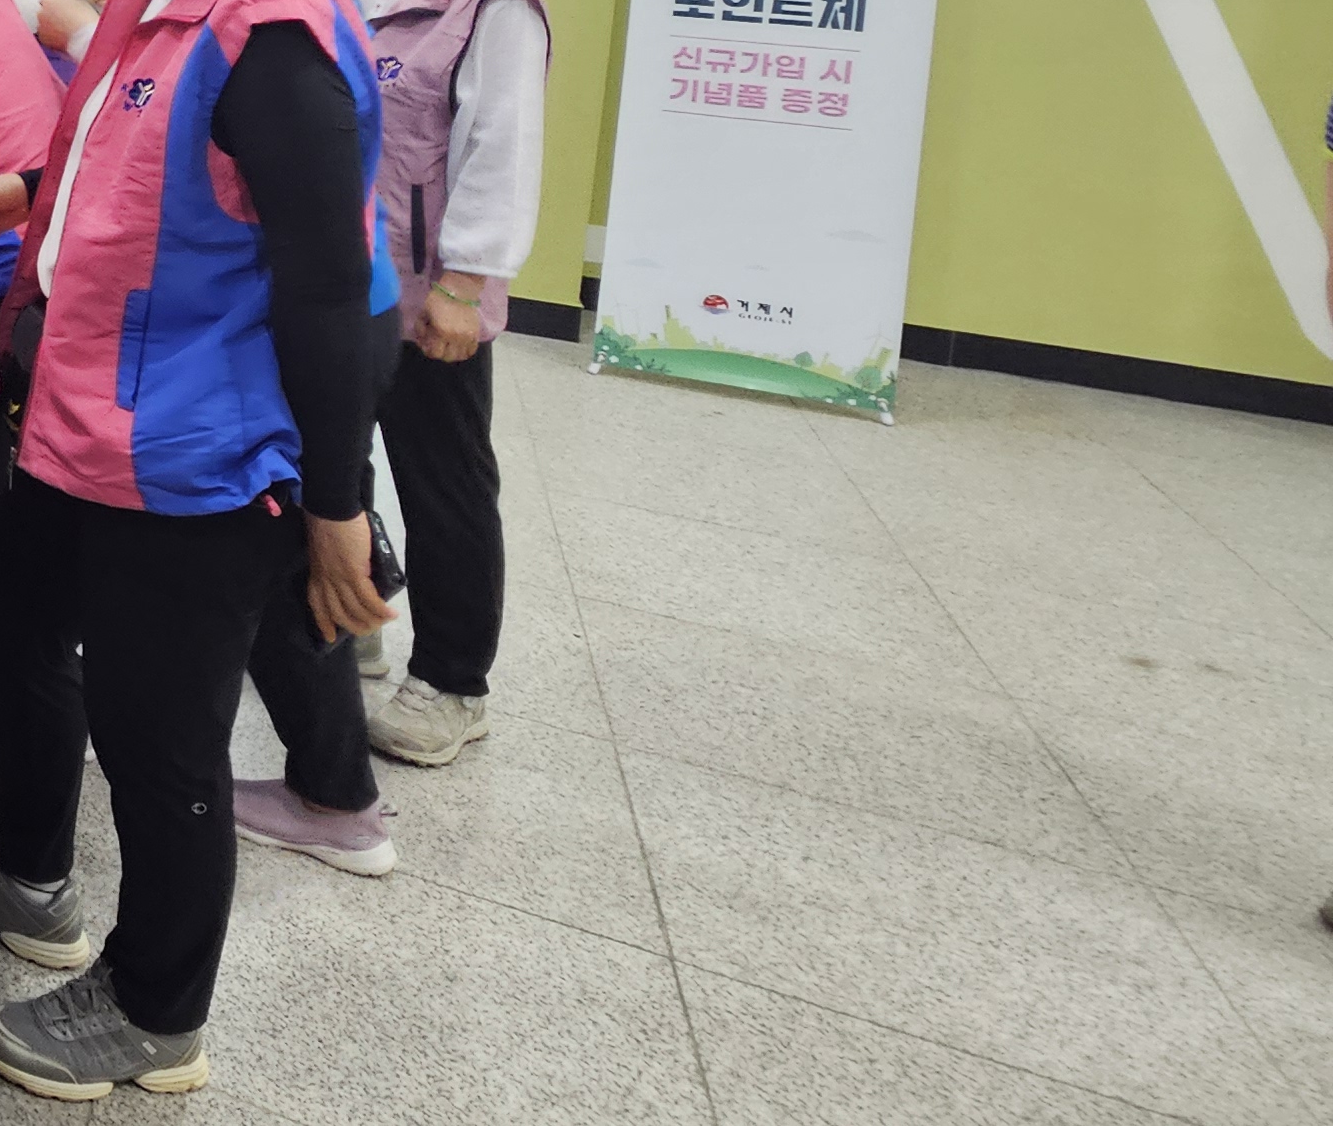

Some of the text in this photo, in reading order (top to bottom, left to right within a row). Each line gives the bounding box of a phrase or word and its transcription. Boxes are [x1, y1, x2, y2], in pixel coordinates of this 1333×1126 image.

[672, 46, 853, 84] 신규가입 시
[669, 77, 849, 118] 기념품 증정
